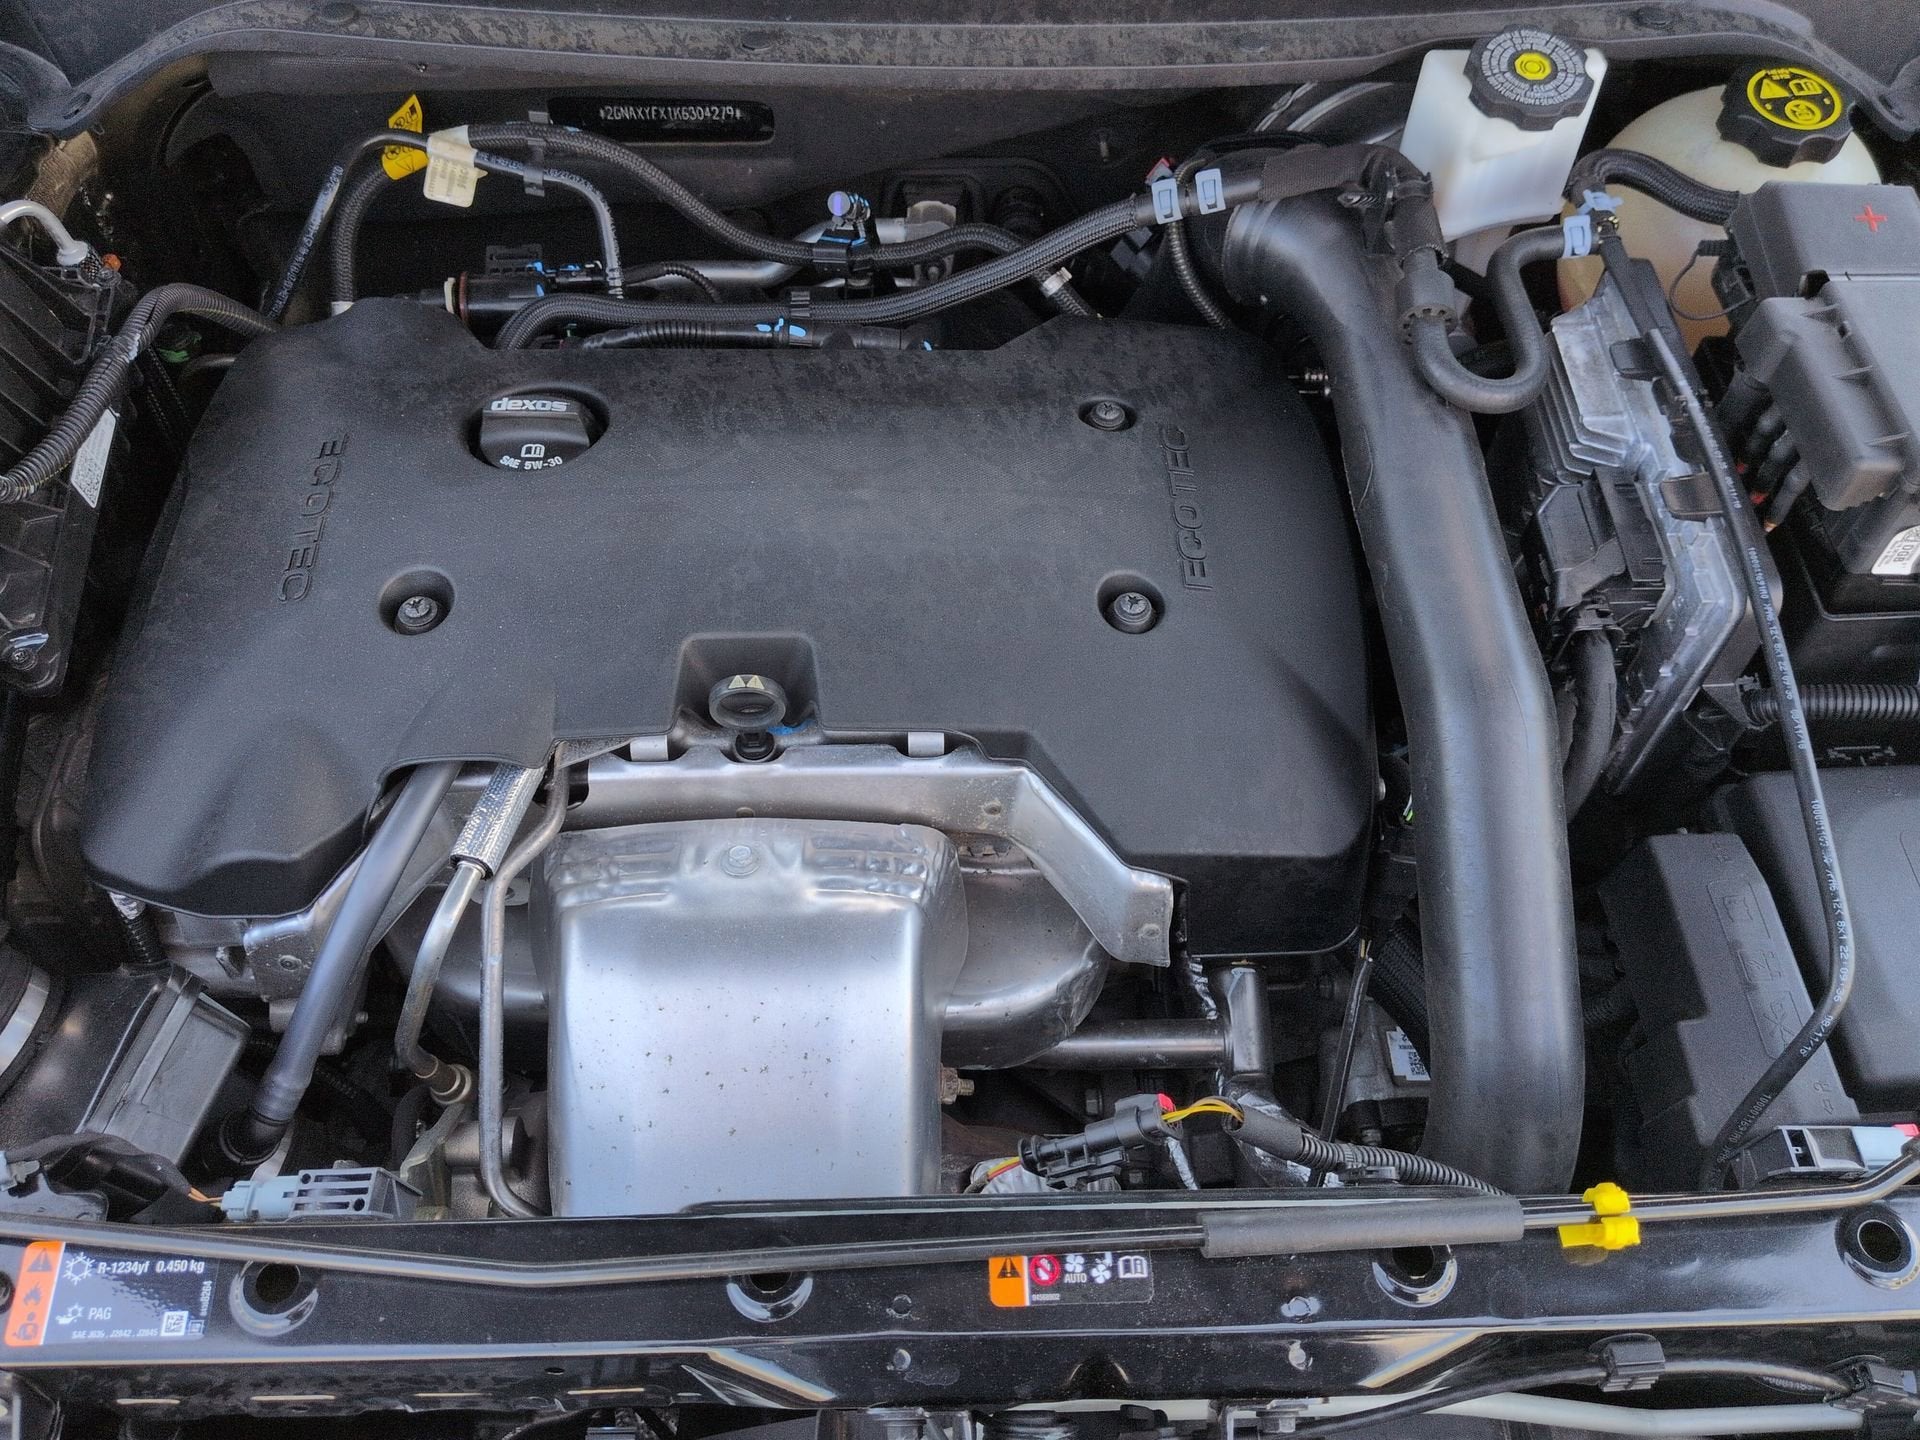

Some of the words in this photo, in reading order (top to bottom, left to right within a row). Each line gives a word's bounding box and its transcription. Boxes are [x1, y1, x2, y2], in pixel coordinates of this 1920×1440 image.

[490, 397, 570, 412] dexos
[499, 455, 521, 469] SAE
[523, 456, 564, 470] 5W-30
[1161, 426, 1213, 590] ECOTEC
[279, 432, 350, 604] ECOTEC
[97, 1260, 150, 1275] R-1234yf
[155, 1260, 188, 1274] 0.450
[190, 1259, 205, 1275] kg
[1064, 1273, 1088, 1284] AUTO
[88, 1307, 112, 1320] PAG
